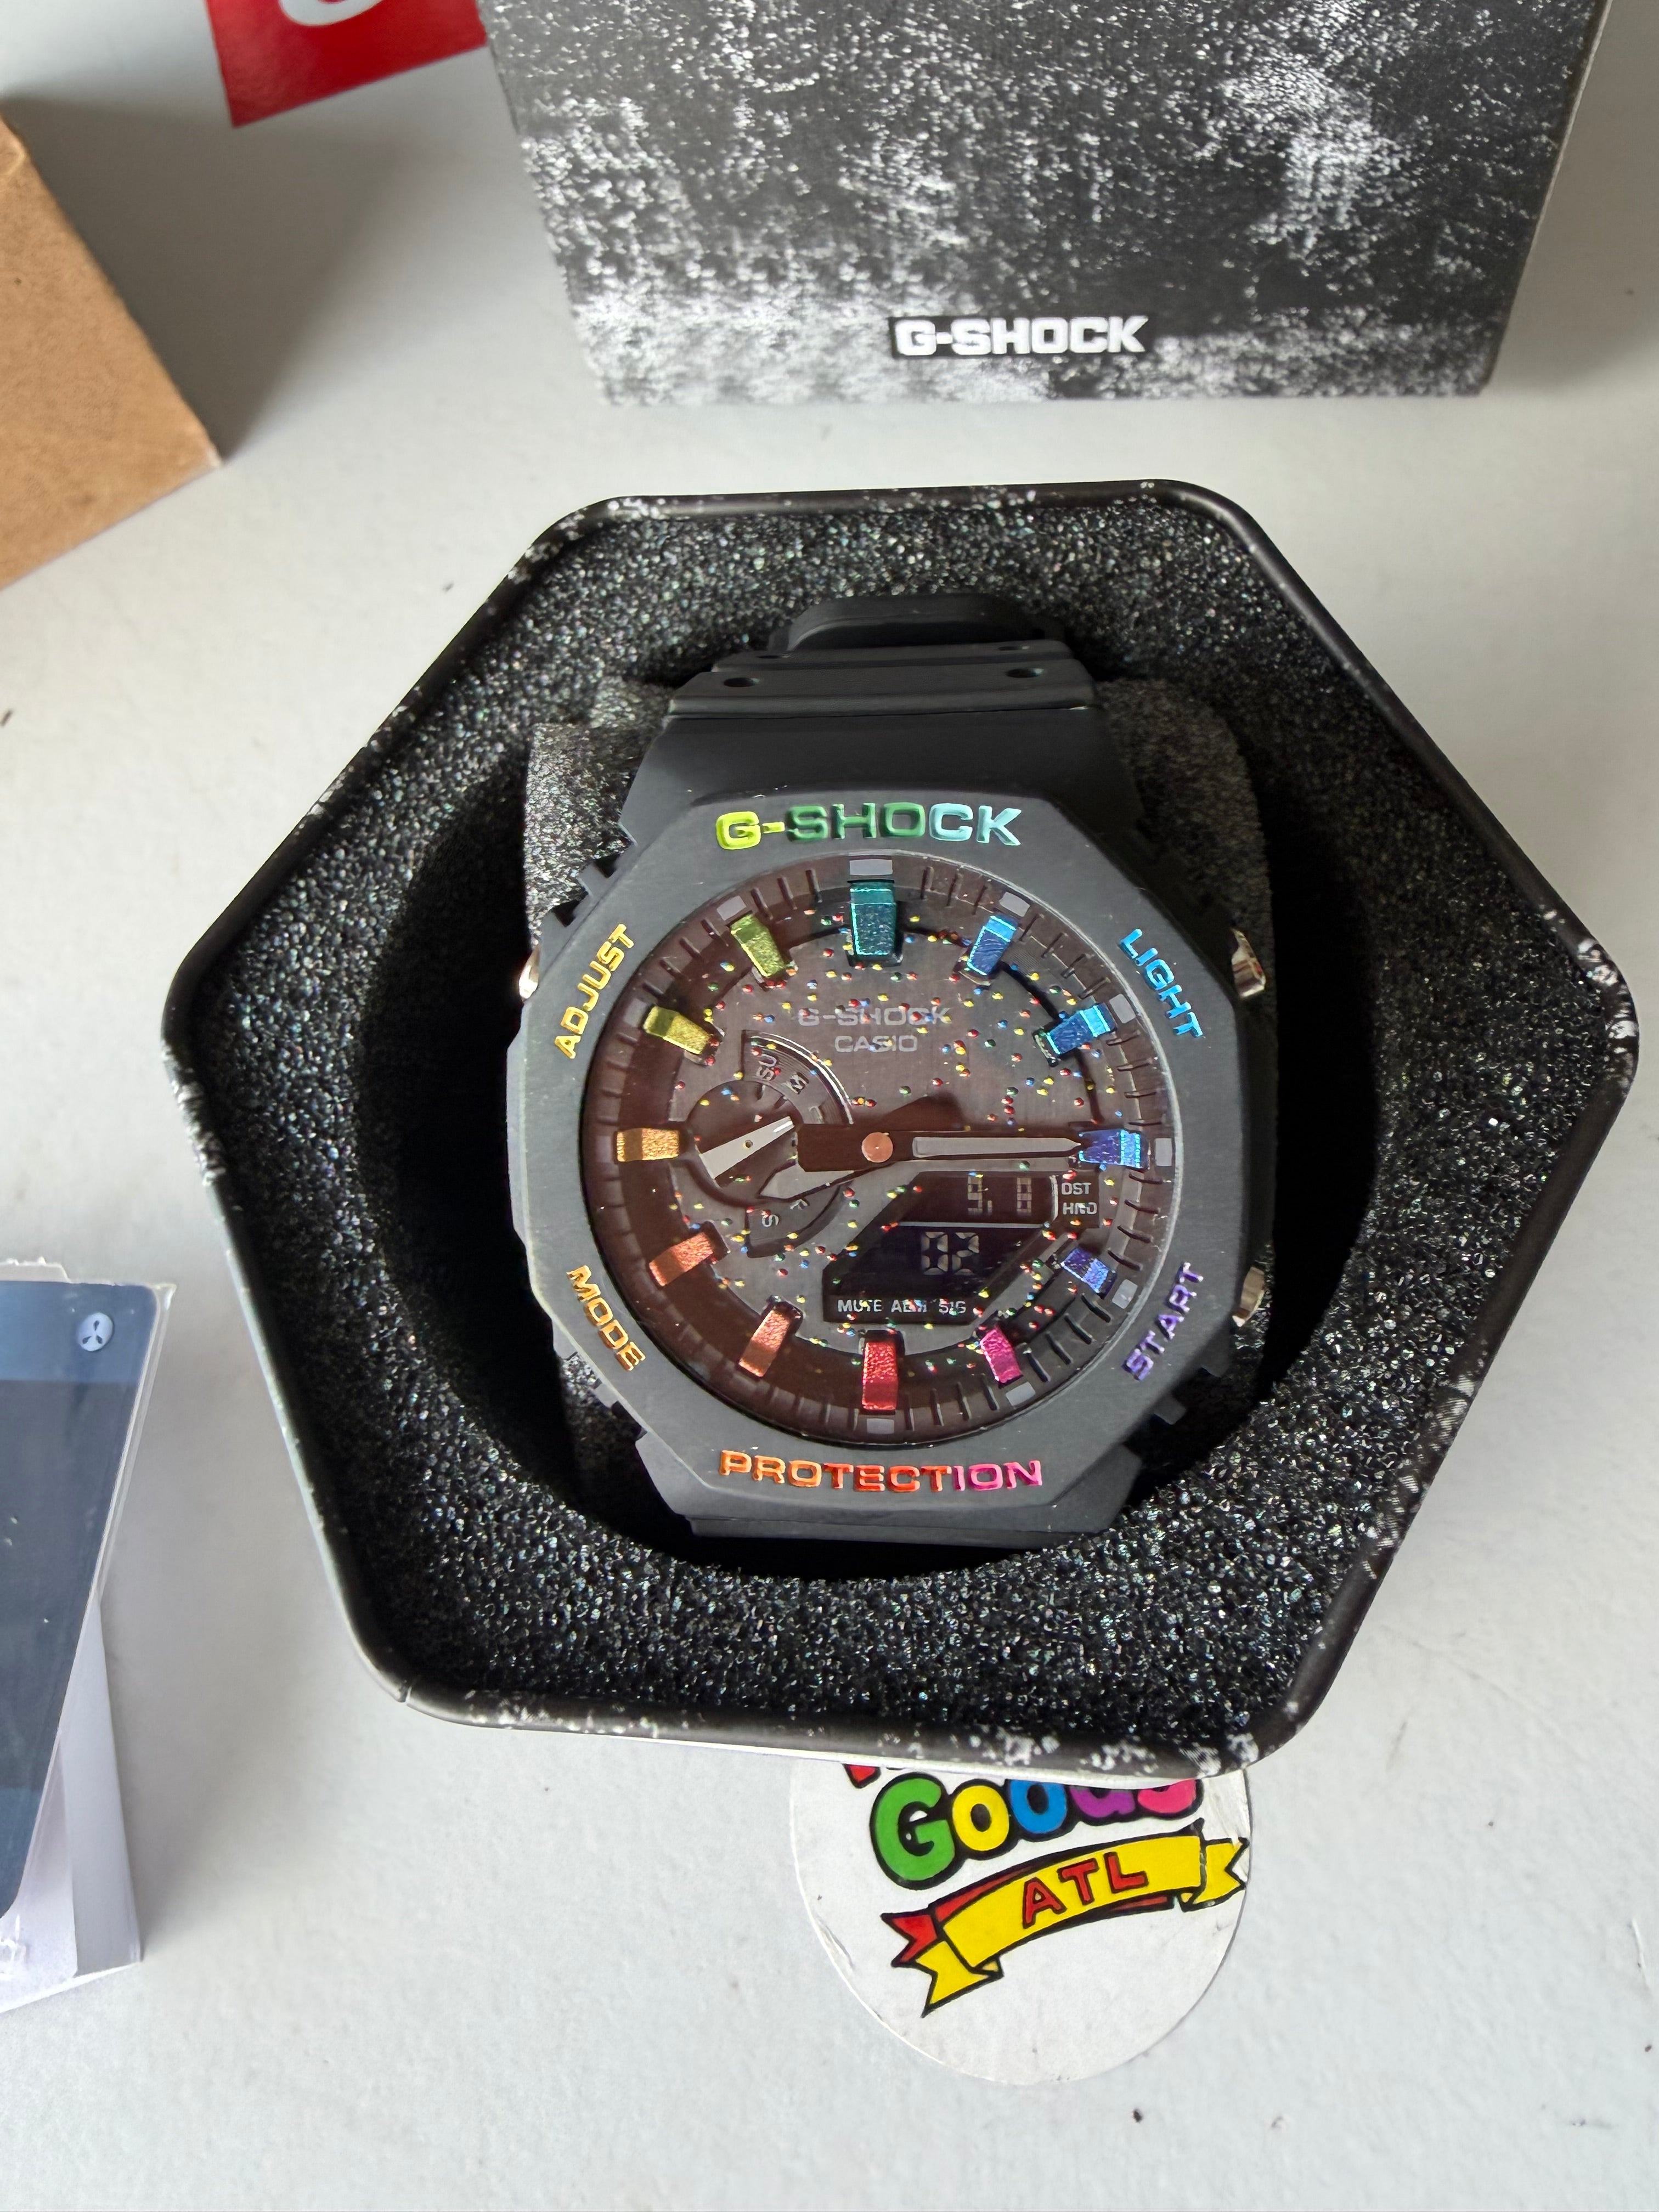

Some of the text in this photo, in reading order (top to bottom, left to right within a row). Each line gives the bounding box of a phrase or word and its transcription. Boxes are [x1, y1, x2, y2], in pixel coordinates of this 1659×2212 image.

[895, 315, 1148, 356] G-SHOCK
[715, 802, 1021, 850] G-SHOCK
[555, 923, 634, 1059] ADJUST
[1118, 928, 1203, 1037] LIGHT
[798, 1007, 952, 1026] G-SHOCK
[834, 1035, 918, 1053] CASIO
[1061, 1182, 1091, 1195] DST
[921, 1231, 979, 1276] 02
[566, 1265, 646, 1371] MODE
[838, 1299, 882, 1313] MUTE
[1124, 1262, 1204, 1381] START
[719, 1450, 1042, 1492] PROTECTION
[1022, 1852, 1148, 1929] ATL
